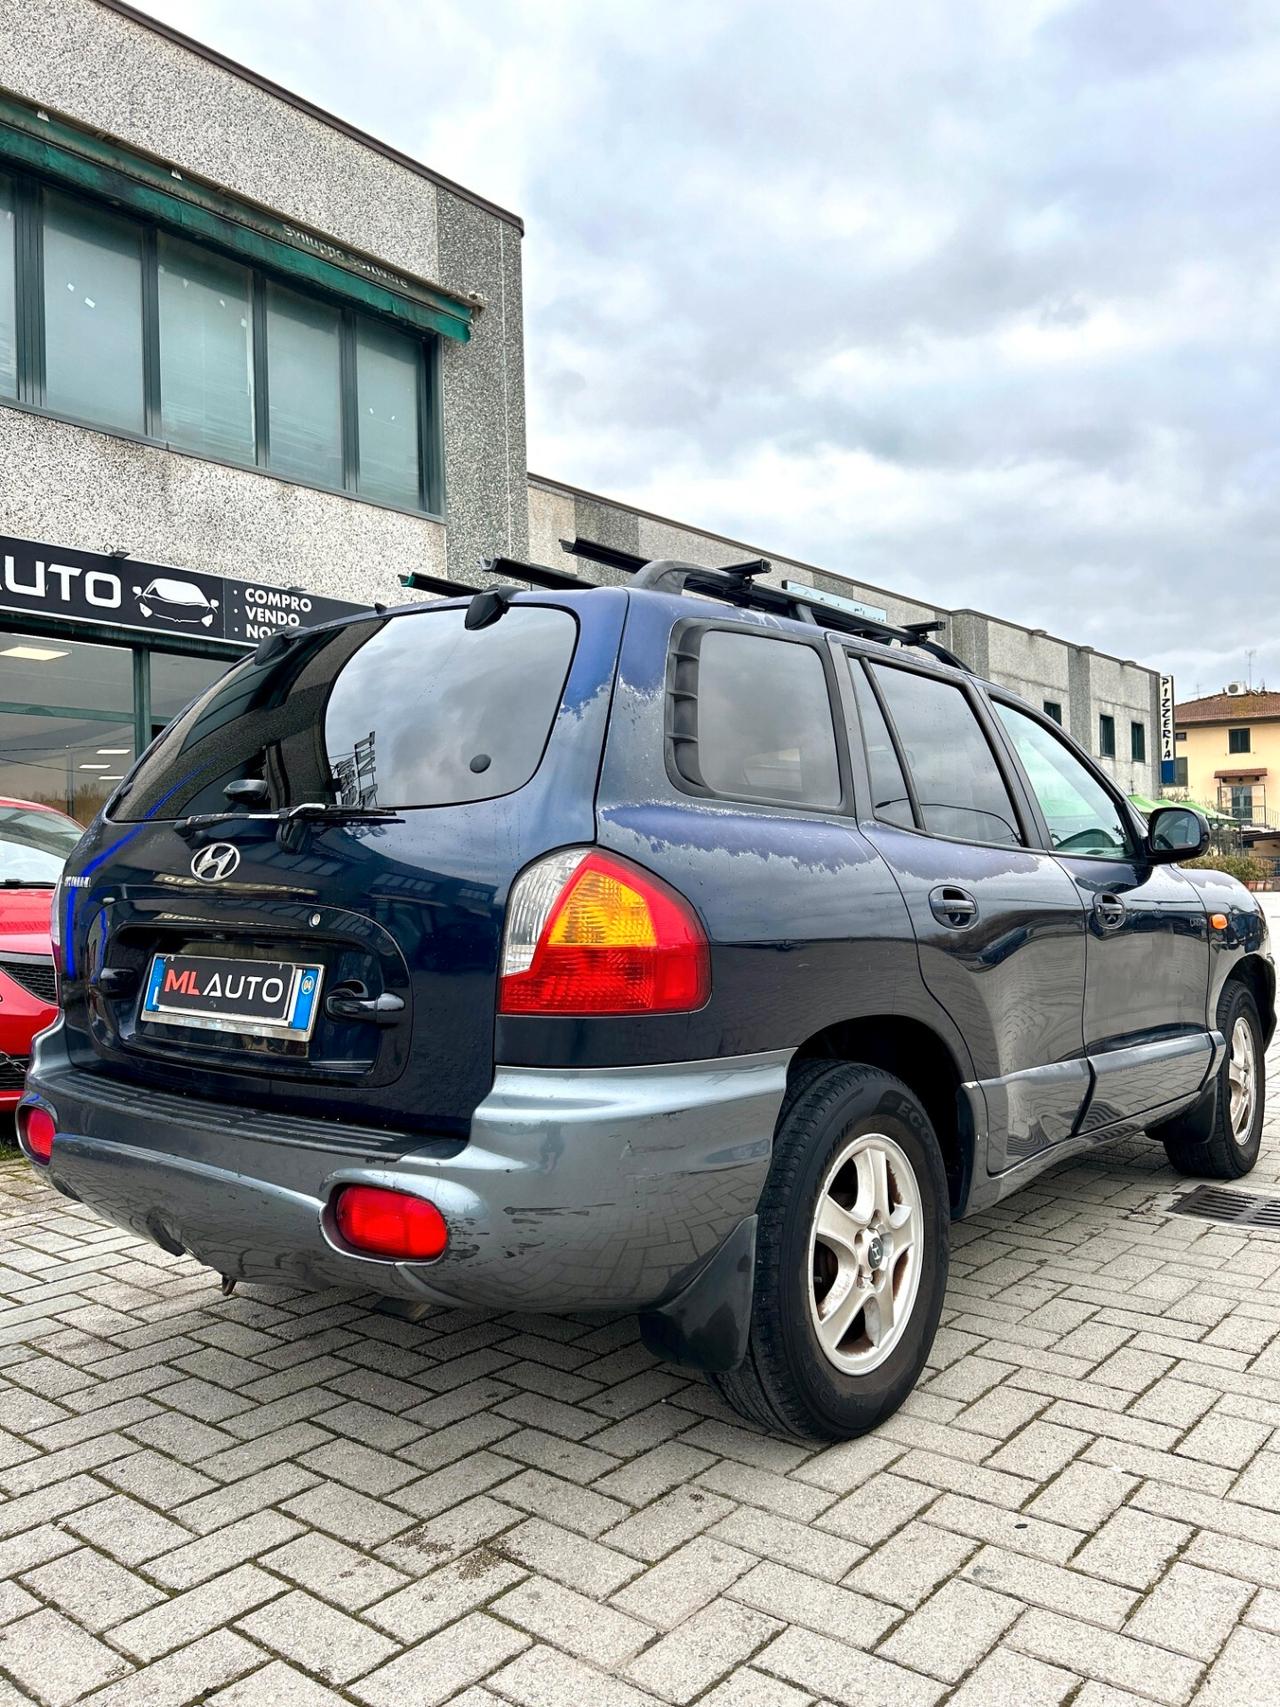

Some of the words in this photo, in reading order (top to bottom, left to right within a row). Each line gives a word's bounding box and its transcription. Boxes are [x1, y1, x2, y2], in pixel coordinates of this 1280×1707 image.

[0, 555, 122, 608] UTO
[246, 588, 312, 612] COMPRO
[246, 607, 300, 627] VENDO
[1161, 677, 1172, 759] PIZZERIA
[163, 968, 200, 995] ML
[202, 972, 284, 1003] AUTO
